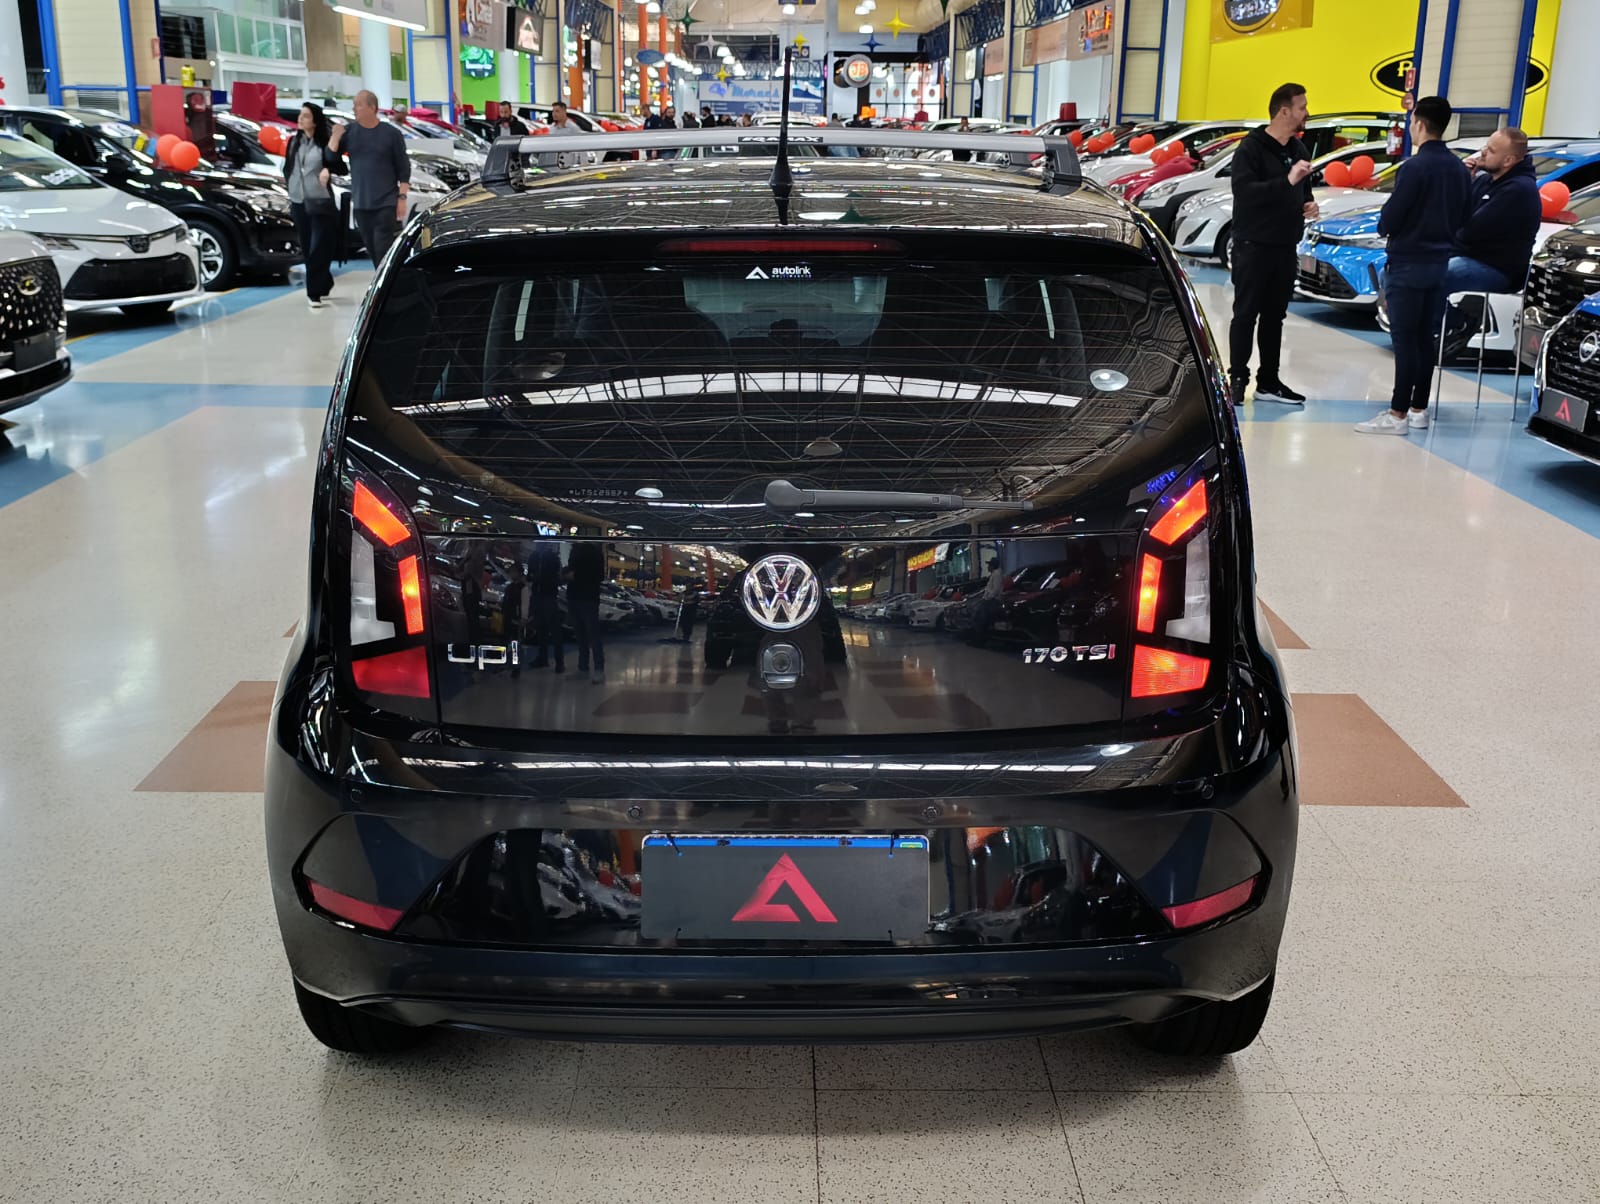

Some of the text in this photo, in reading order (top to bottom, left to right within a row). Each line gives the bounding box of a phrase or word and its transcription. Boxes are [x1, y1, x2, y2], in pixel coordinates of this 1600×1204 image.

[771, 265, 811, 275] autolink
[1022, 644, 1116, 663] 170 TSI
